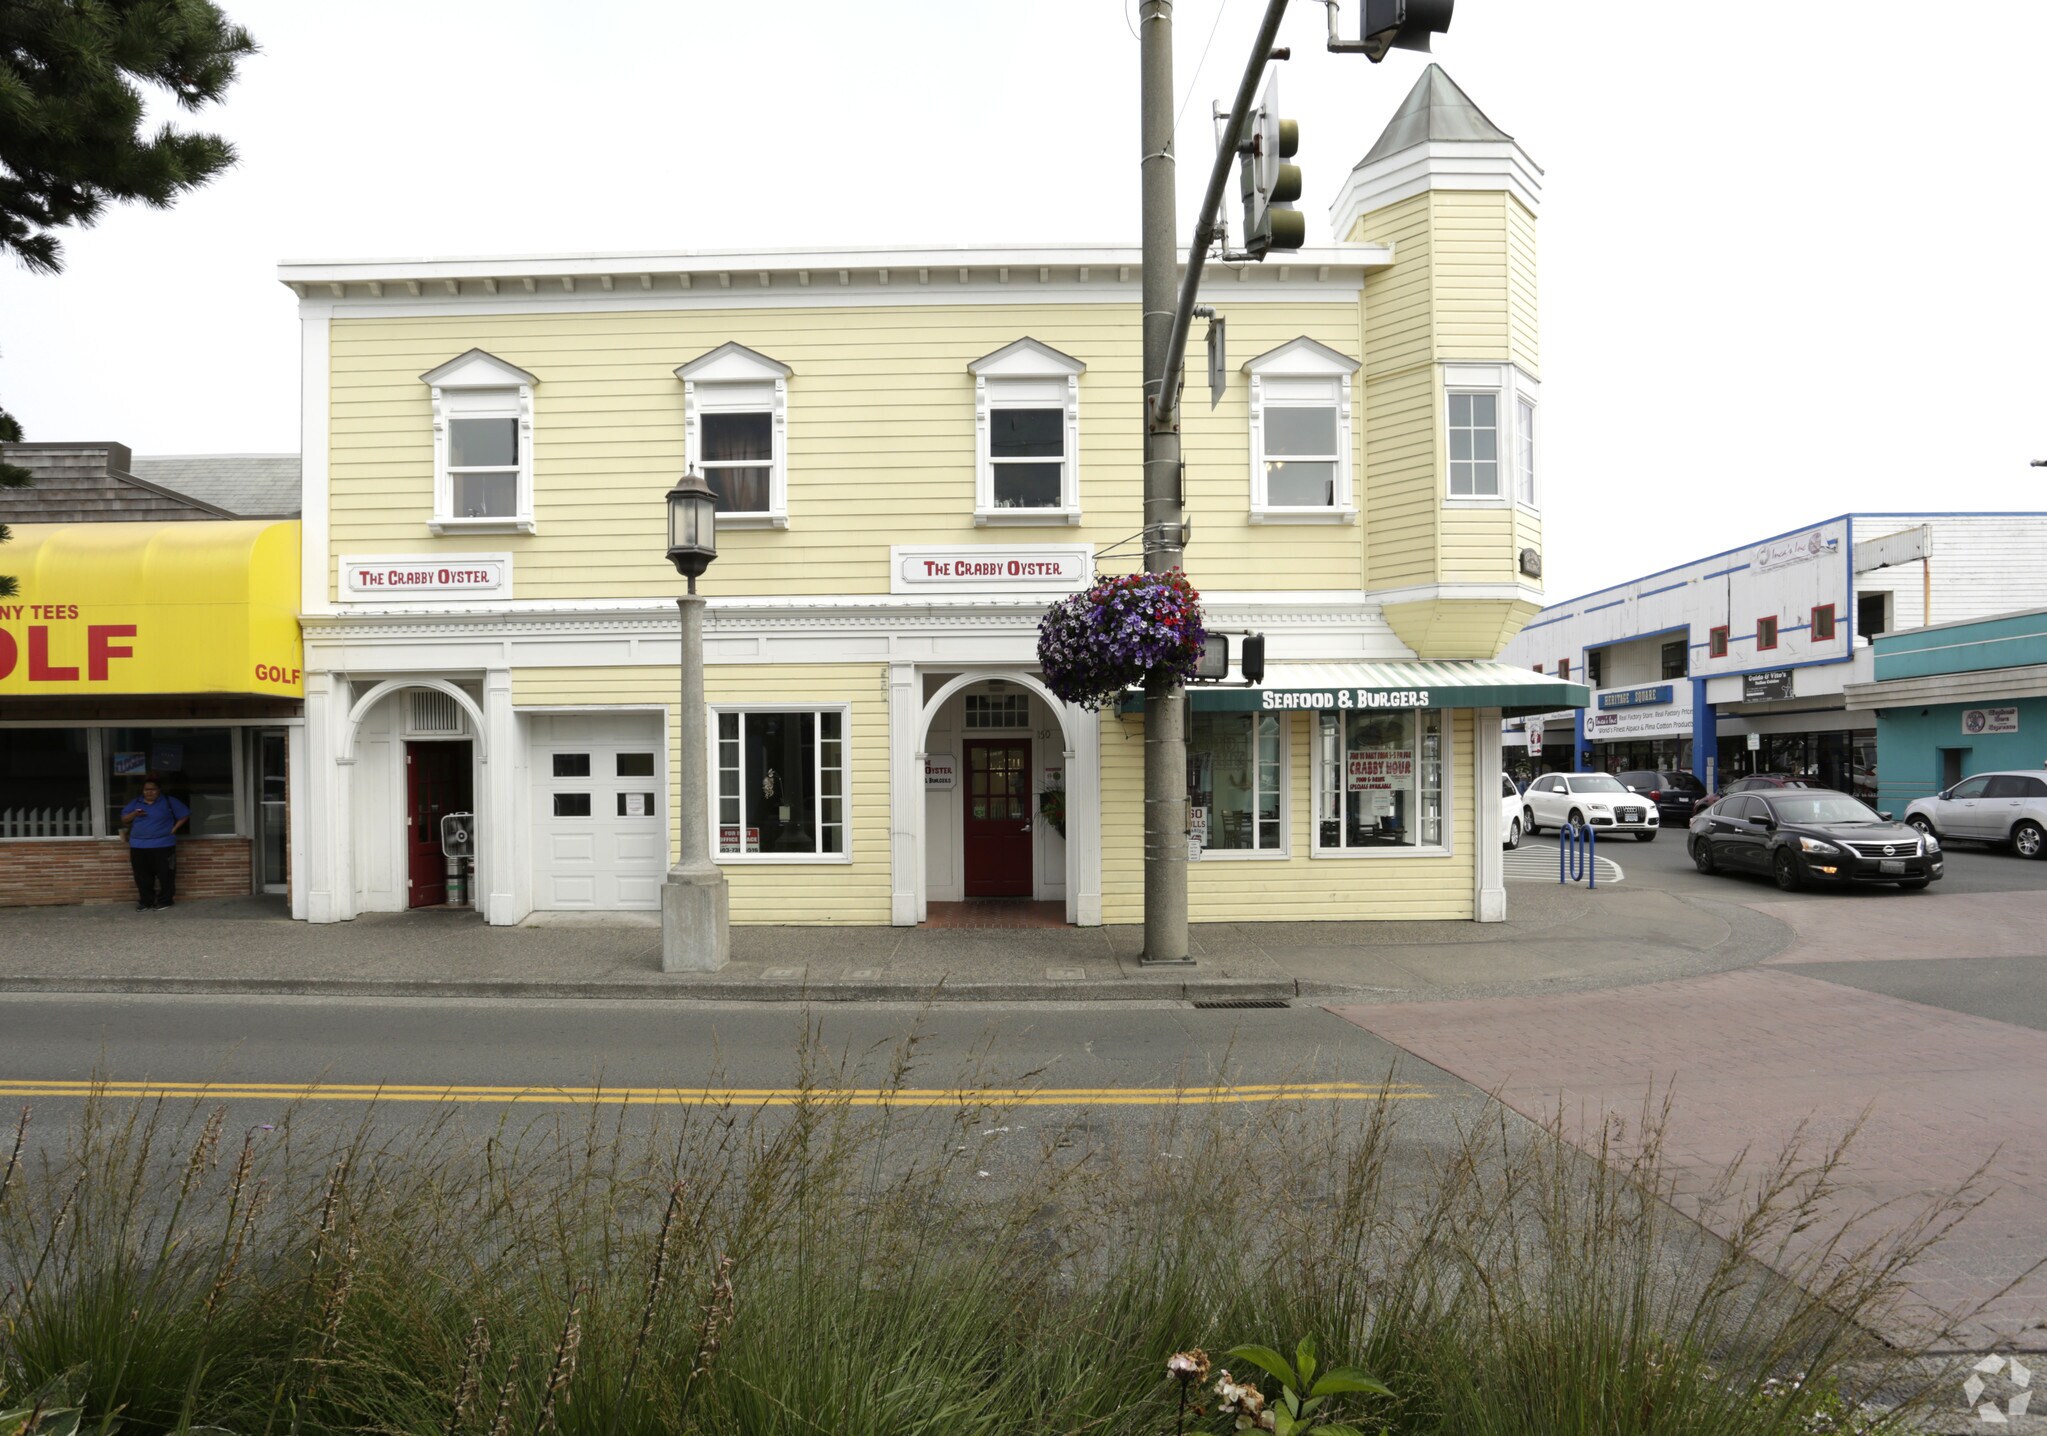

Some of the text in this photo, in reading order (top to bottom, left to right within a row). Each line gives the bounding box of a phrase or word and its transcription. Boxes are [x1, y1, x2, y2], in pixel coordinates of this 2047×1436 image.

[955, 560, 1004, 576] CRABBY
[1007, 560, 1062, 576] OYSTER
[388, 570, 434, 585] CRABBY
[438, 569, 489, 584] OYSTER
[31, 604, 79, 620] TEES
[255, 663, 300, 685] GOLF
[1262, 690, 1429, 709] SEAFOOD & BURGERS
[1604, 689, 1656, 706] HERITAGE SQUARE
[1628, 713, 1642, 722] Factory
[1665, 709, 1680, 718] Factory
[1350, 761, 1411, 775] CRABBY HOUR
